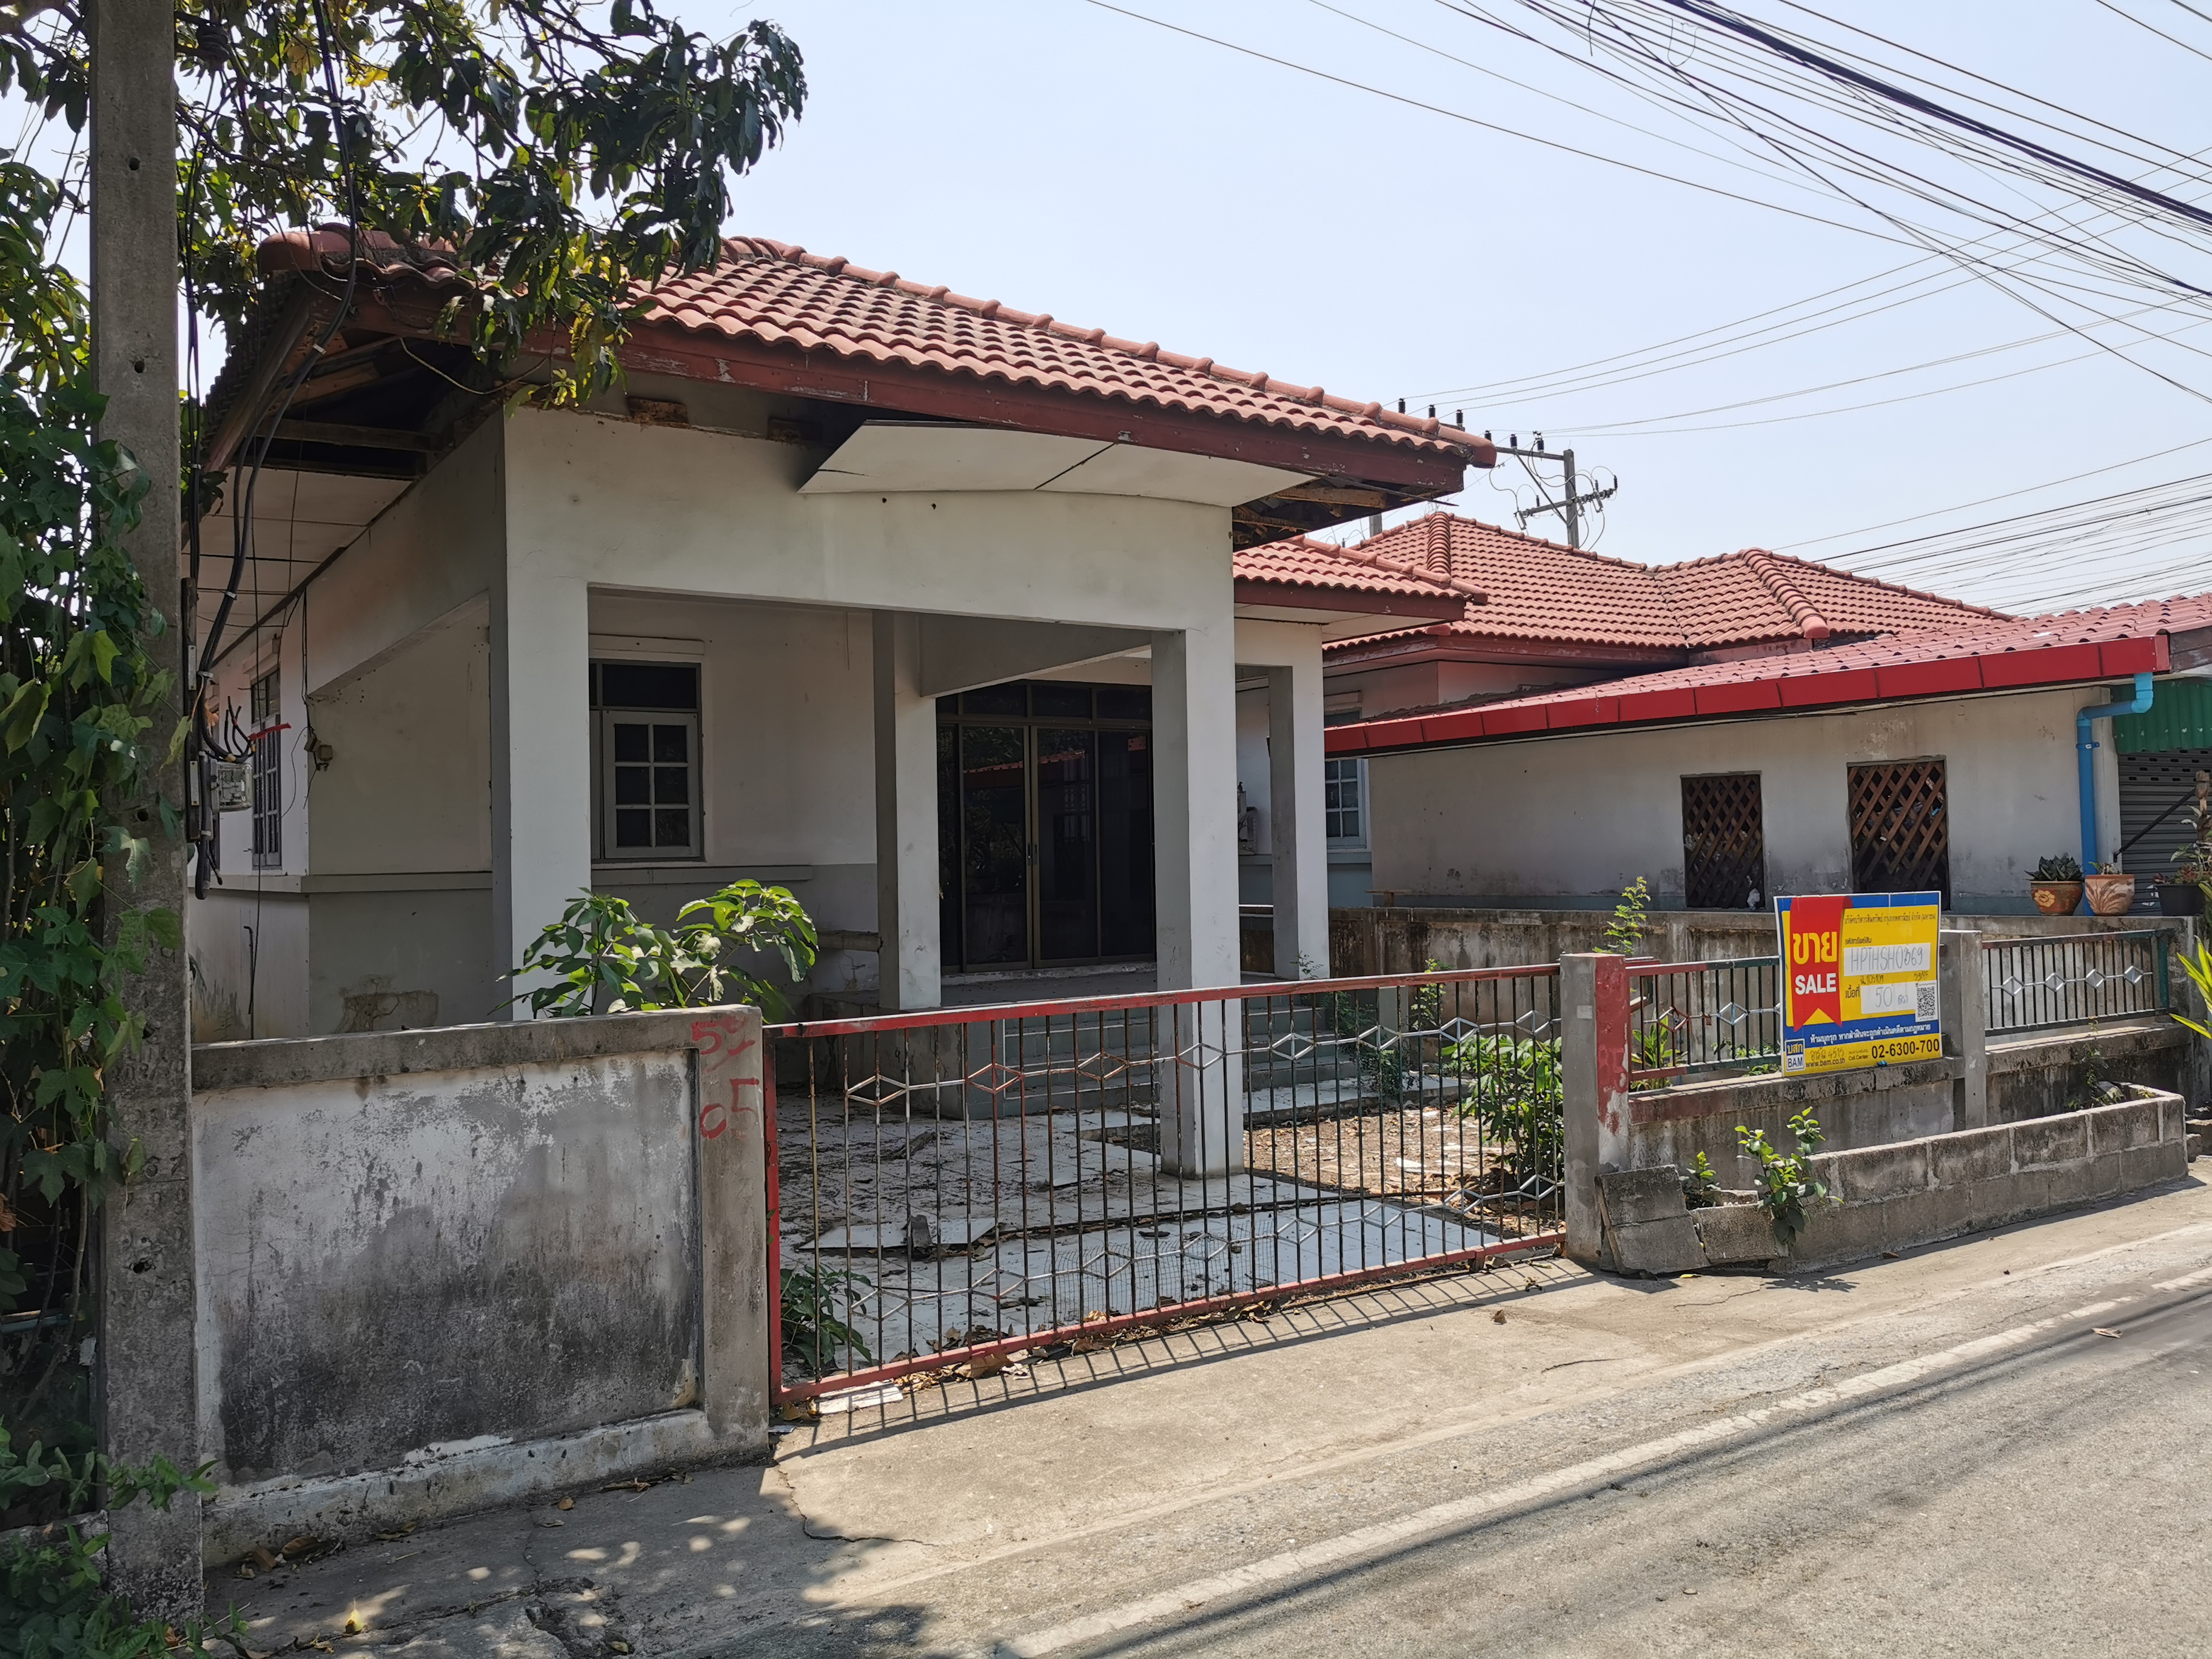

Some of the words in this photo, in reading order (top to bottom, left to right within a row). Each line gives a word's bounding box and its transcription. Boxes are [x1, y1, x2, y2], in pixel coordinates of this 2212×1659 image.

[1792, 931, 1837, 965] ขาย
[1795, 973, 1837, 995] SALE
[1875, 987, 1892, 1008] 50
[1810, 1033, 1837, 1045] ห้ามบุกรุก
[1787, 1043, 1803, 1054] บสก
[1872, 1039, 1940, 1059] 02-6300-700
[1788, 1057, 1803, 1068] BAM
[1805, 1057, 1845, 1068] www.bam.co.th
